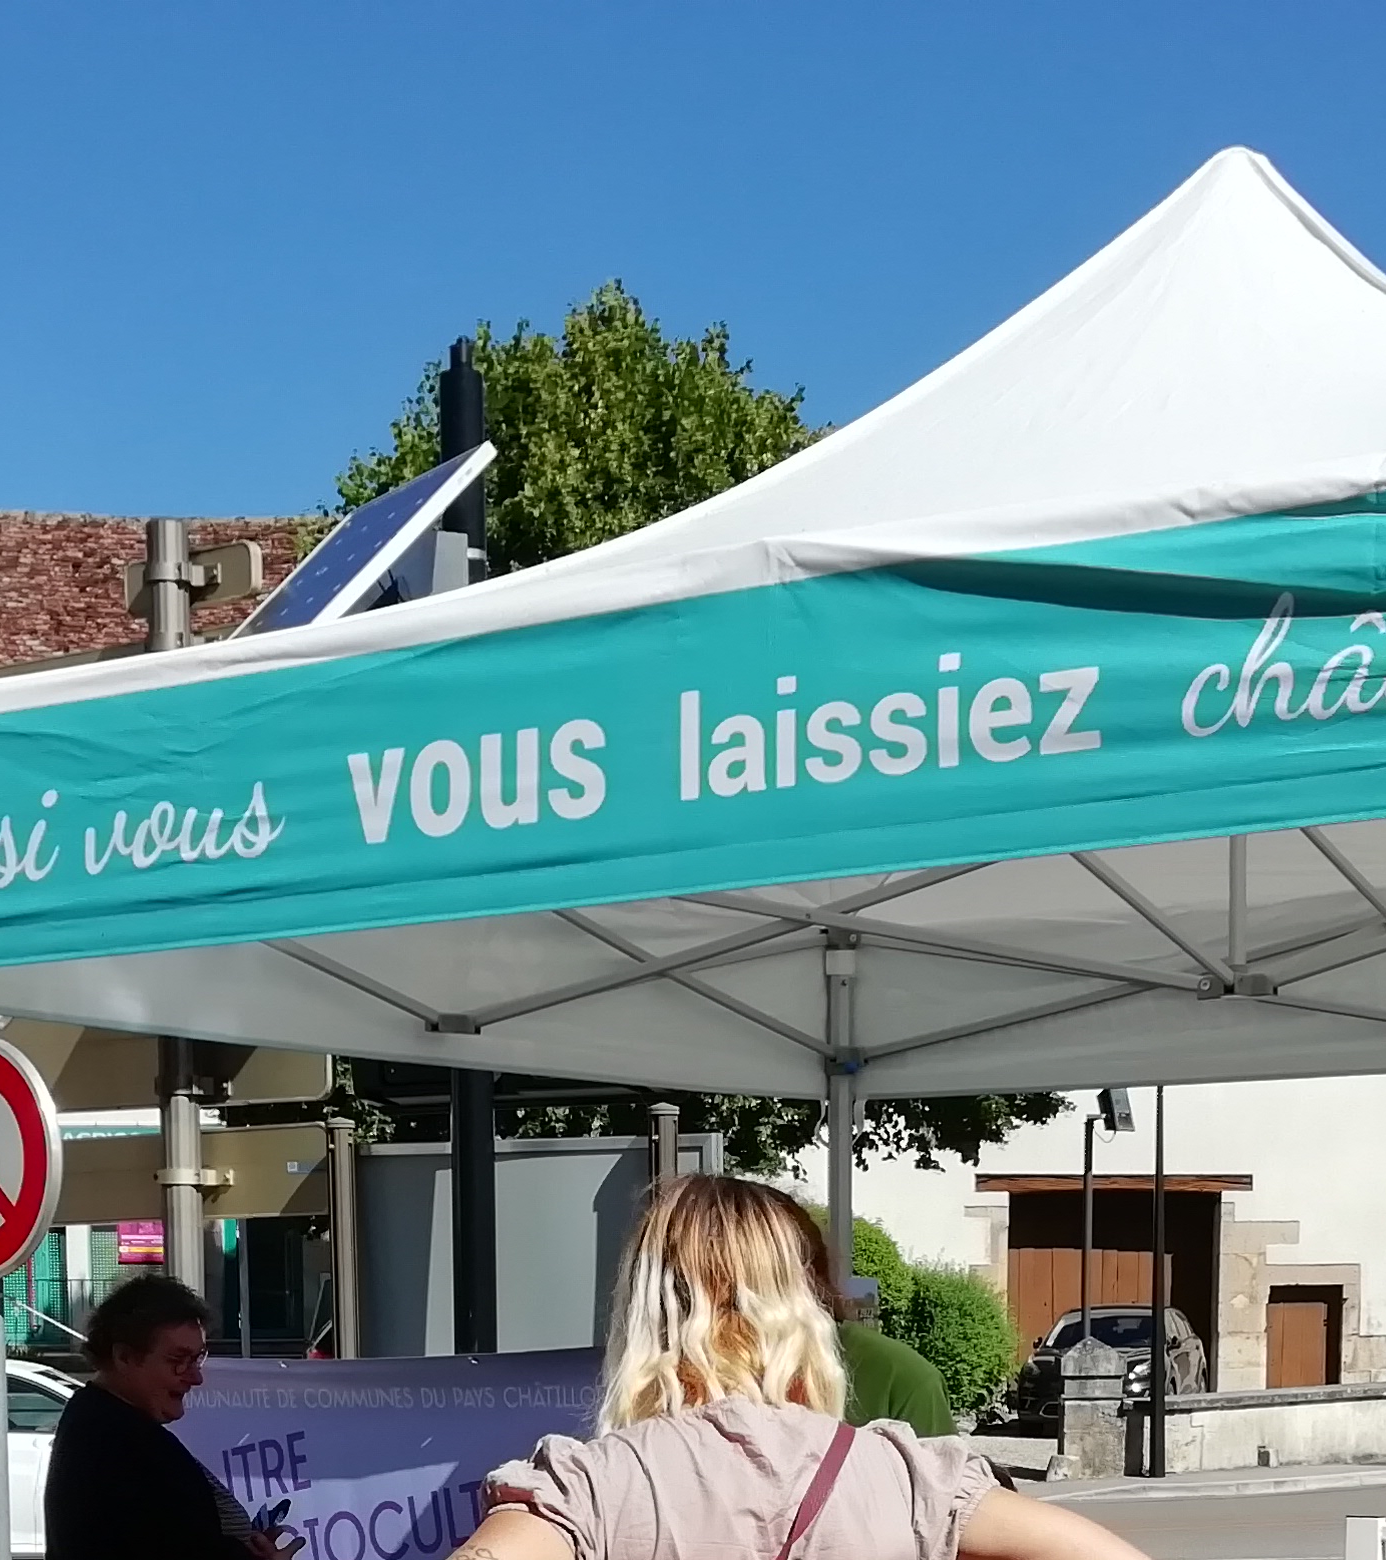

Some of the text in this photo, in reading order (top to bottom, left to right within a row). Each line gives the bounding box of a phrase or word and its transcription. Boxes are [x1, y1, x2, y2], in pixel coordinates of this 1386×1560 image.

[84, 780, 286, 876] vous
[348, 717, 607, 845] vous
[679, 652, 1102, 802] laissiez
[276, 1388, 297, 1409] DE
[303, 1387, 414, 1411] COMMUNES
[421, 1387, 447, 1409] DU
[452, 1386, 495, 1409] PAYS
